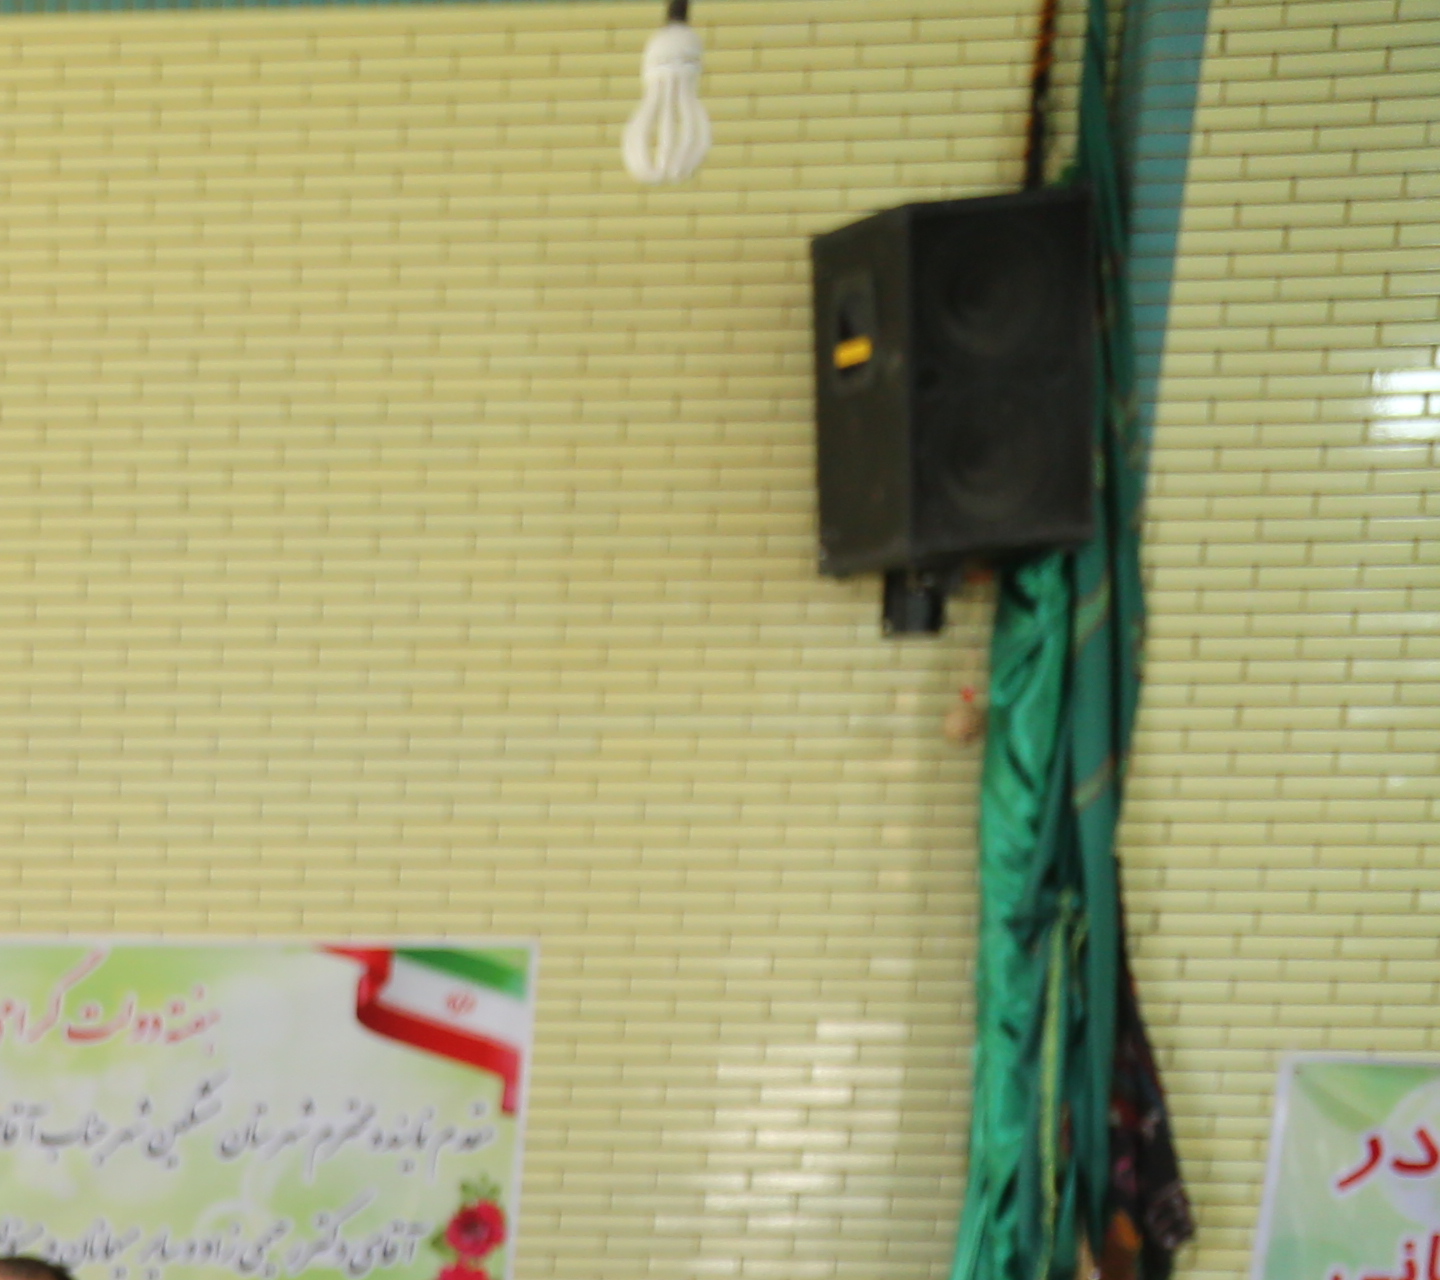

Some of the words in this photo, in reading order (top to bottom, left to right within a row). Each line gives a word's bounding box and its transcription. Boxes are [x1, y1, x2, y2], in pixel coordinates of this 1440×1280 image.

[65, 996, 164, 1044] دولت
[166, 984, 222, 1056] هفته
[38, 1111, 108, 1165] جناب
[218, 1096, 314, 1162] شهرستان
[304, 1097, 377, 1181] محترم
[291, 1187, 376, 1274] دکتر
[348, 1219, 429, 1277] آقای
